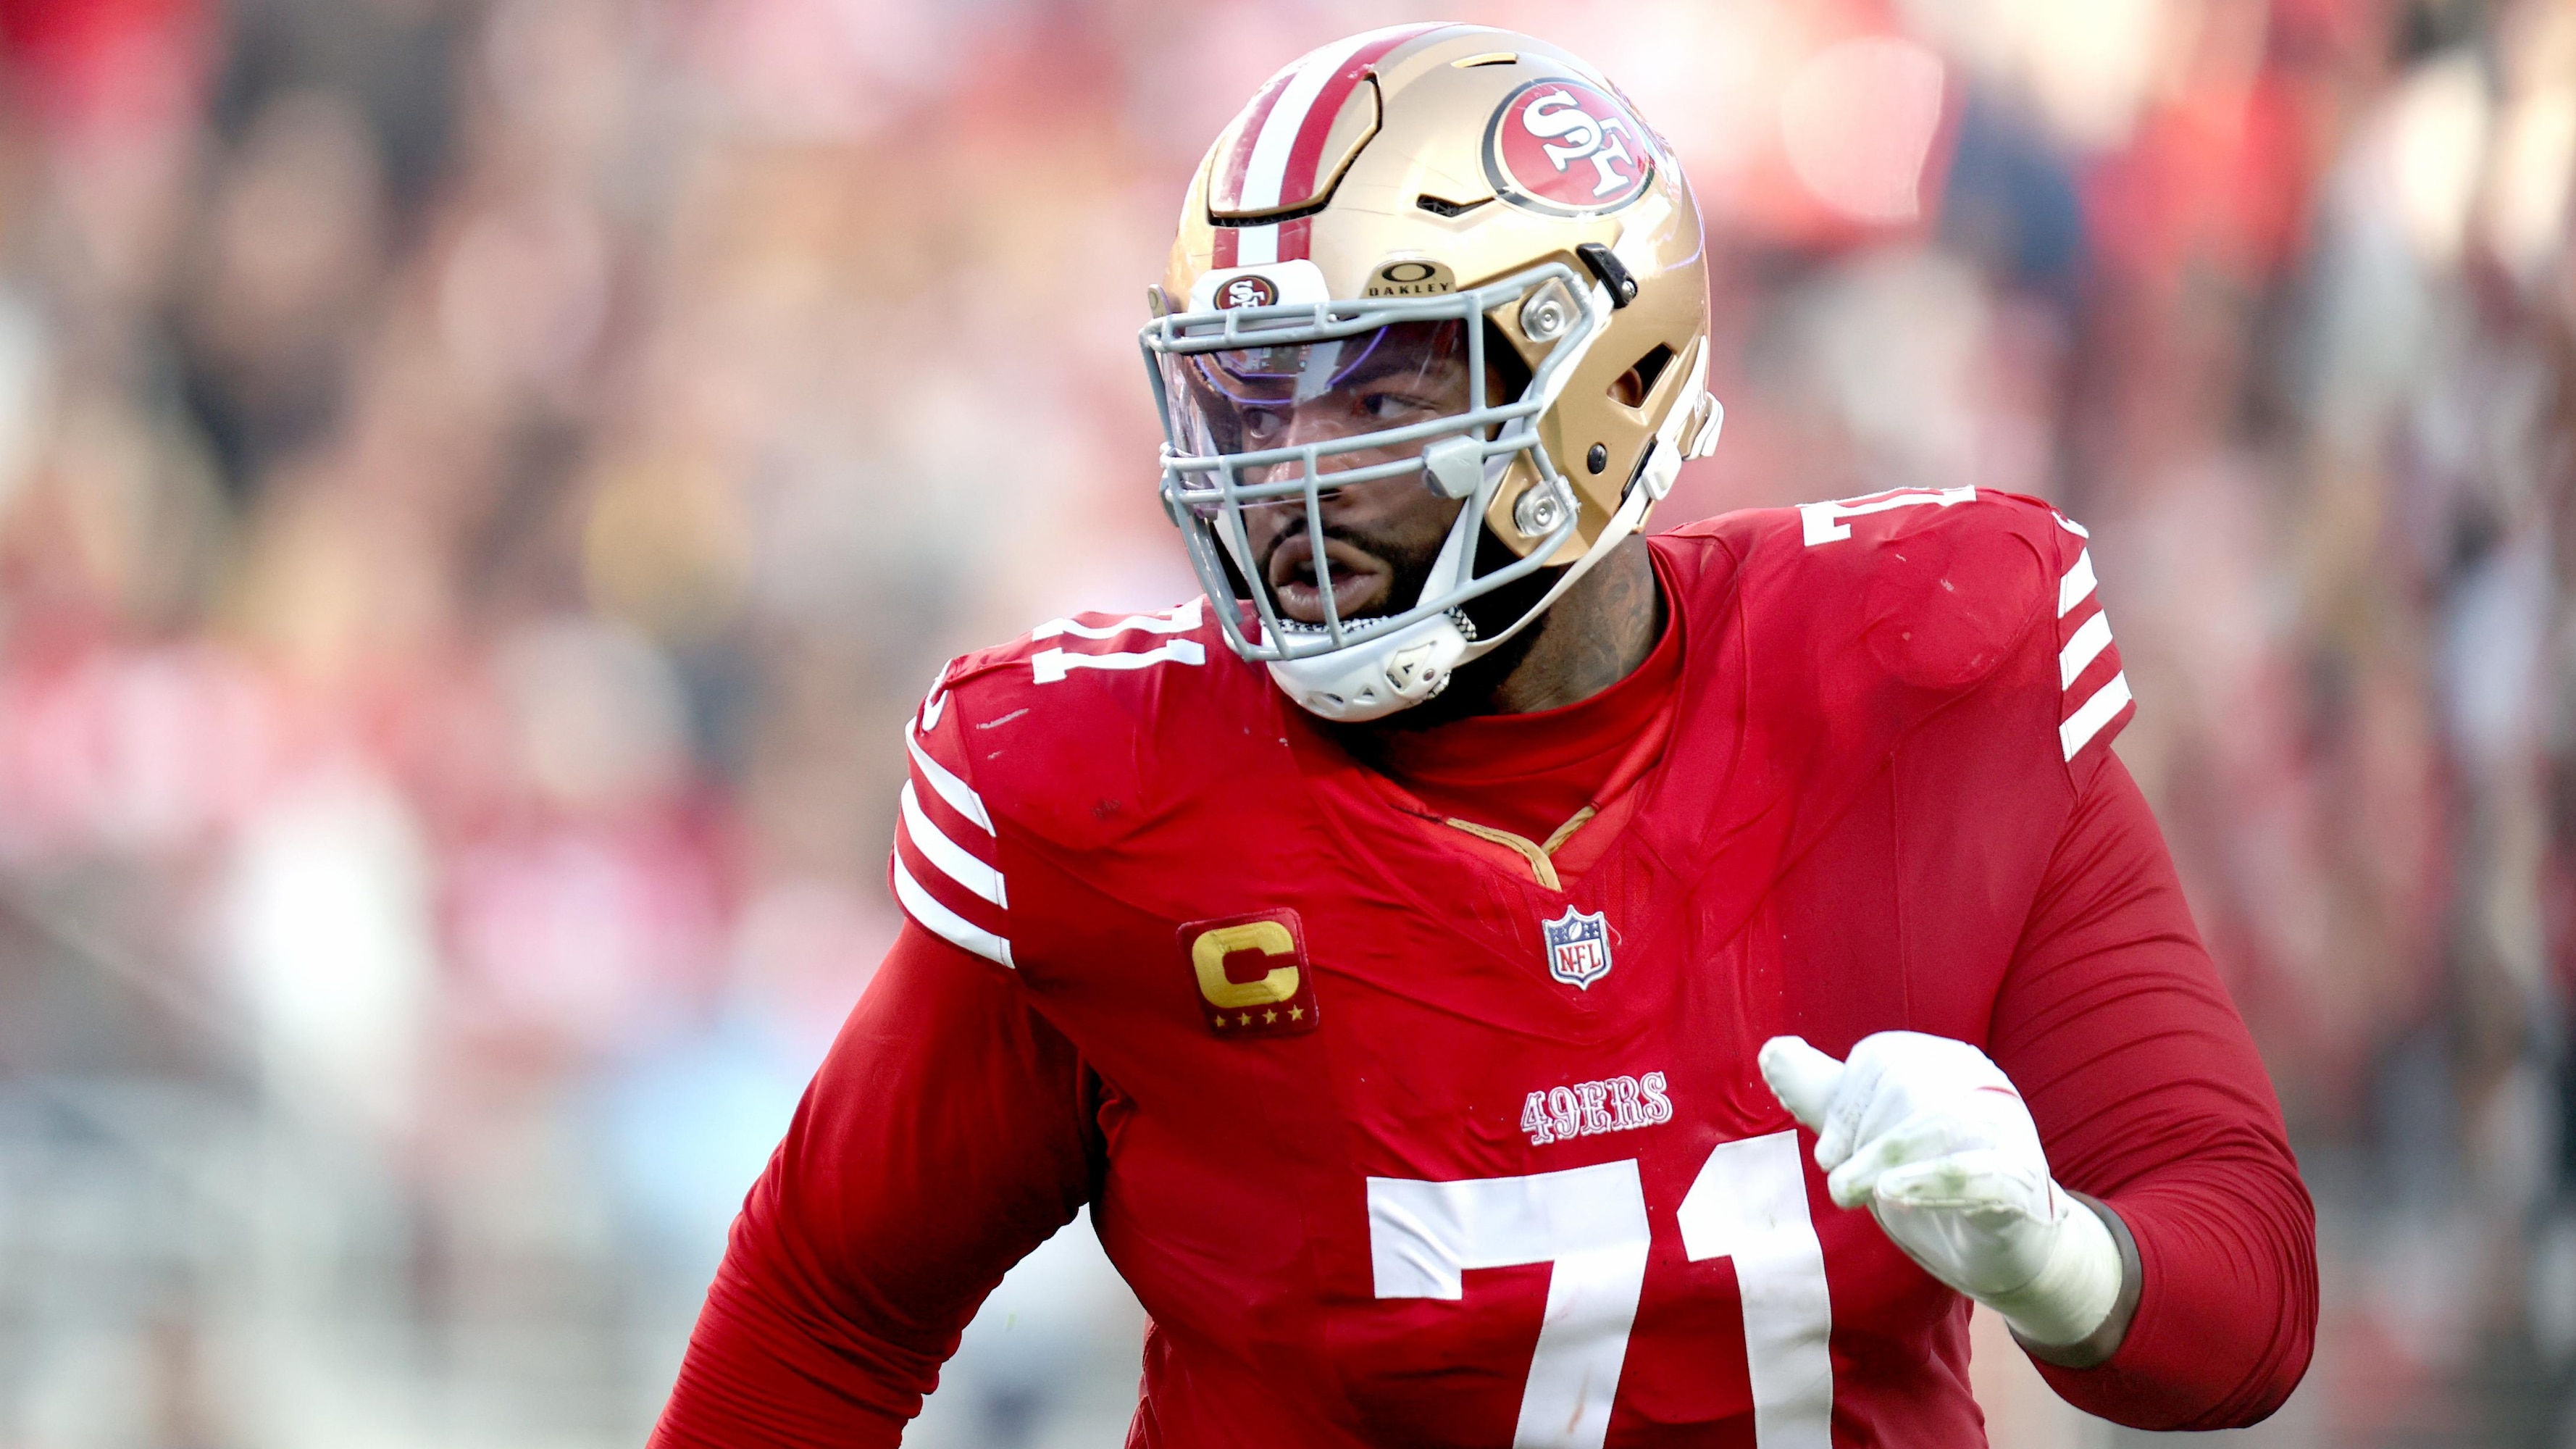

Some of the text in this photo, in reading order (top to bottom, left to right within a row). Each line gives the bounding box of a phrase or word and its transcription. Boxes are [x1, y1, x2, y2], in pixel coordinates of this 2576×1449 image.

[1523, 90, 1634, 198] SF
[1368, 283, 1449, 296] OAKLEY
[1192, 920, 1300, 1009] C
[1557, 943, 1602, 974] NFL
[1521, 1071, 1673, 1146] 49ERS
[1366, 1129, 1833, 1449] 71
